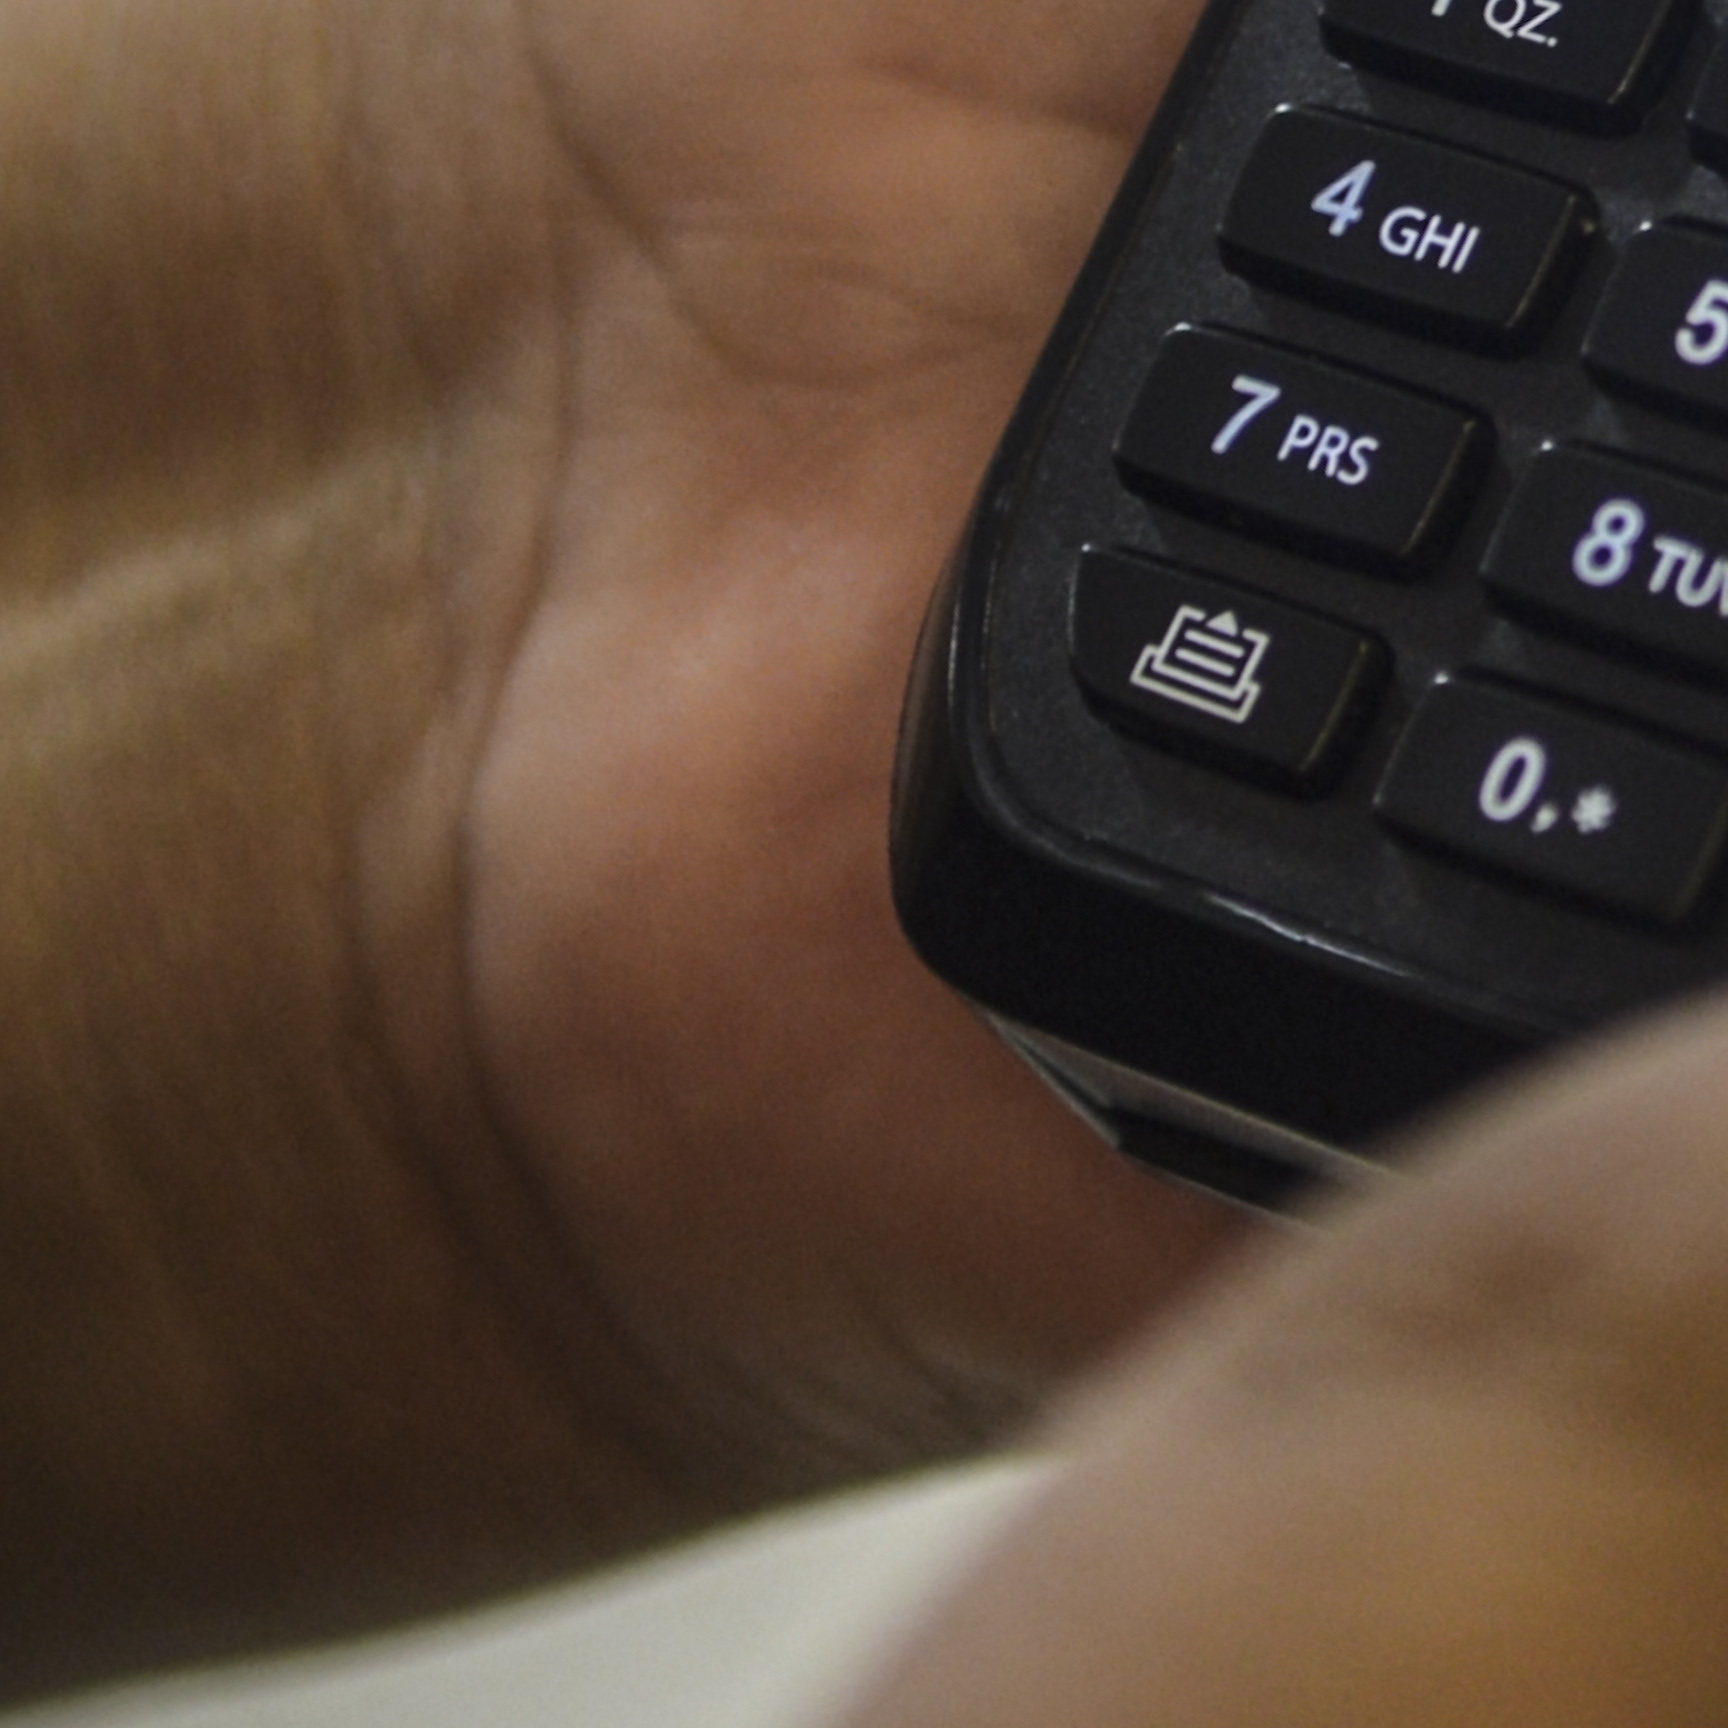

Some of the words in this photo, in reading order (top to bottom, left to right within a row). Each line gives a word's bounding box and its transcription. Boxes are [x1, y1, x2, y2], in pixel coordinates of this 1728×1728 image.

[1310, 160, 1376, 236] 4
[1379, 208, 1479, 273] GHI
[1210, 376, 1279, 454] 7
[1278, 415, 1379, 485] PRS
[1571, 500, 1645, 586] 8
